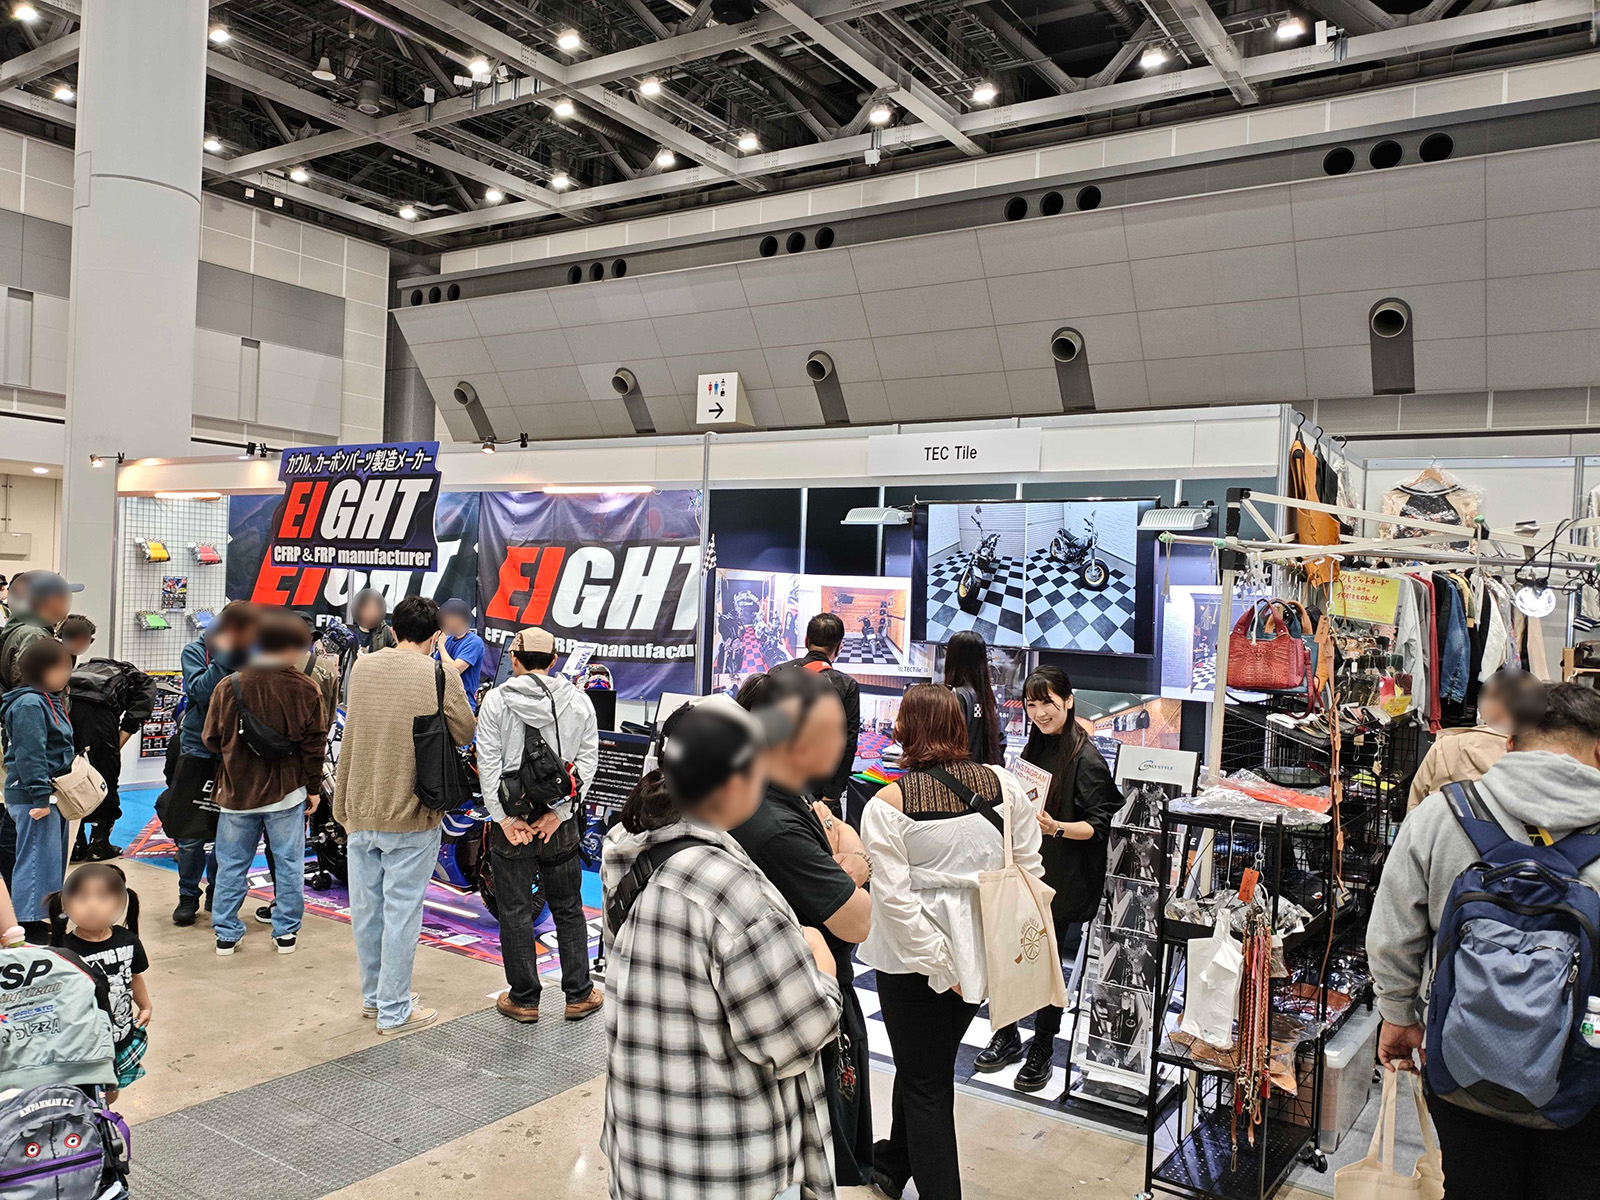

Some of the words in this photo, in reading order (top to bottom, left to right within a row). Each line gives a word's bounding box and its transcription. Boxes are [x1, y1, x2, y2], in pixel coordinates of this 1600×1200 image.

[285, 449, 432, 474] カウル、カーボンパーツ製造メーカー
[924, 446, 949, 461] TEC
[955, 445, 977, 460] Tile
[277, 478, 433, 540] EIGHT
[274, 545, 300, 563] CFRP
[314, 546, 336, 563] FRP
[337, 548, 432, 567] manufacturer
